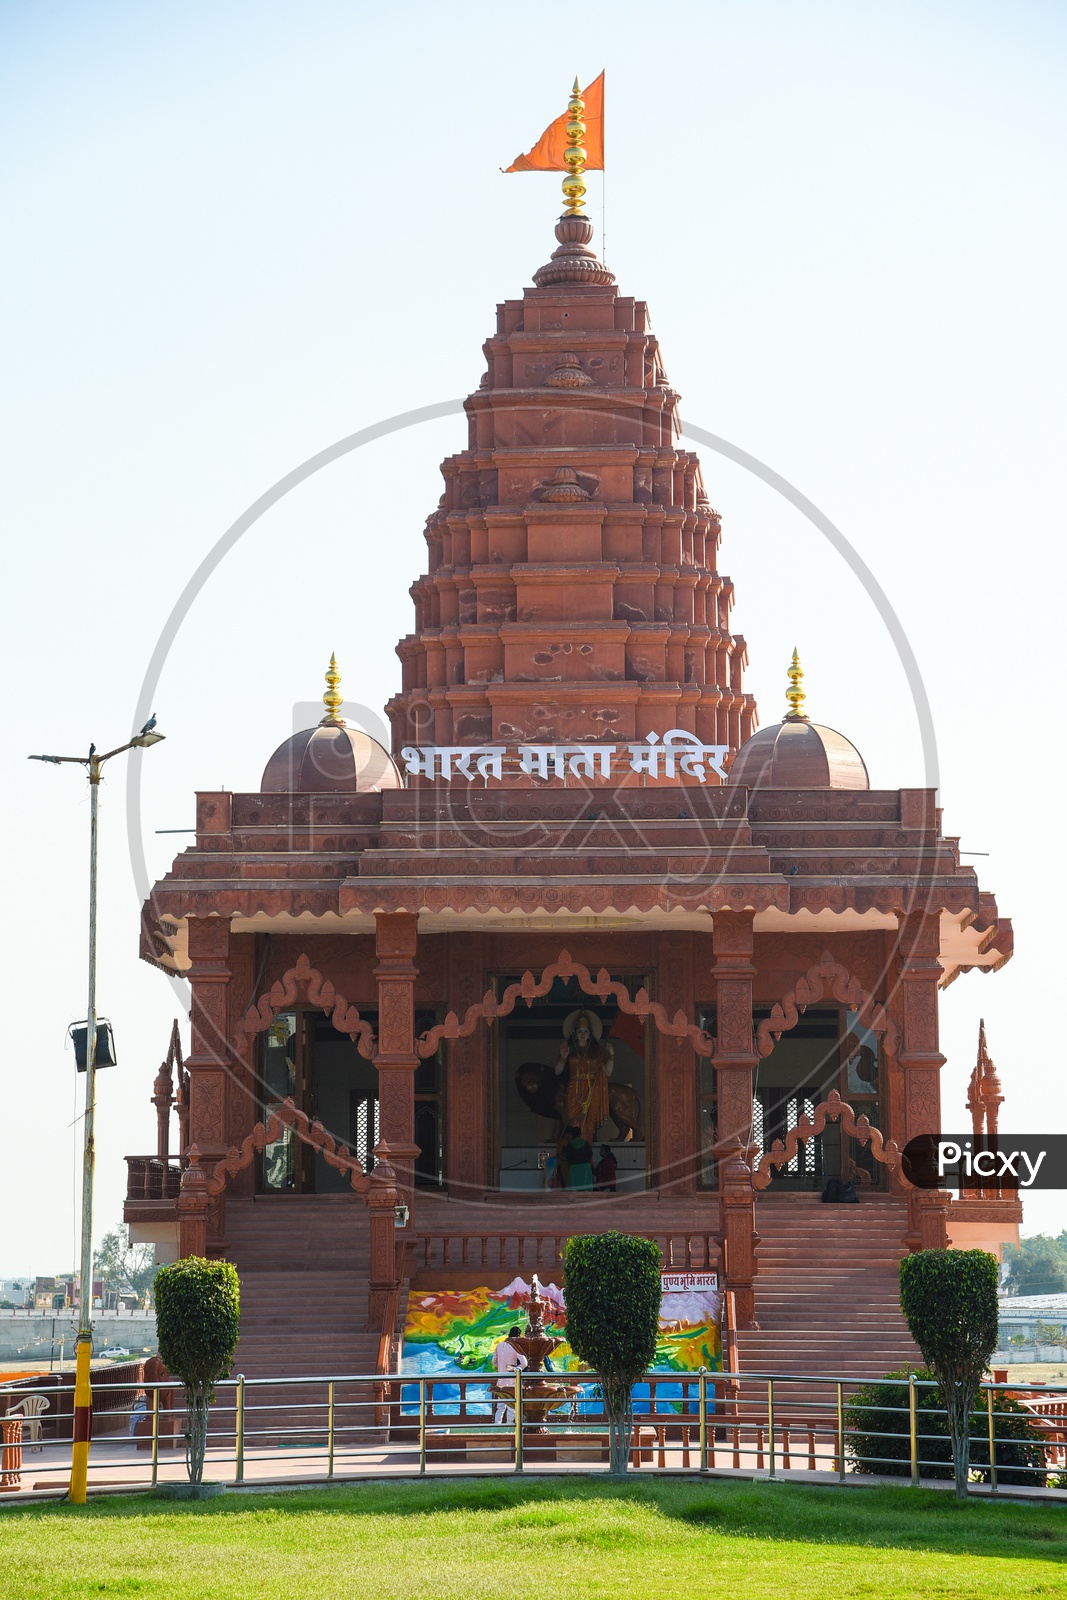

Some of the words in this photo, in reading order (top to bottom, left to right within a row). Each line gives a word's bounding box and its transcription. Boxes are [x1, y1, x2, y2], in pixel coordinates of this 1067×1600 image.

[401, 746, 507, 781] भारत
[518, 745, 616, 780] माता
[628, 729, 730, 783] मंदिर
[663, 1277, 679, 1290] पुण्य
[680, 1274, 695, 1290] भूमि
[697, 1276, 715, 1286] भारत
